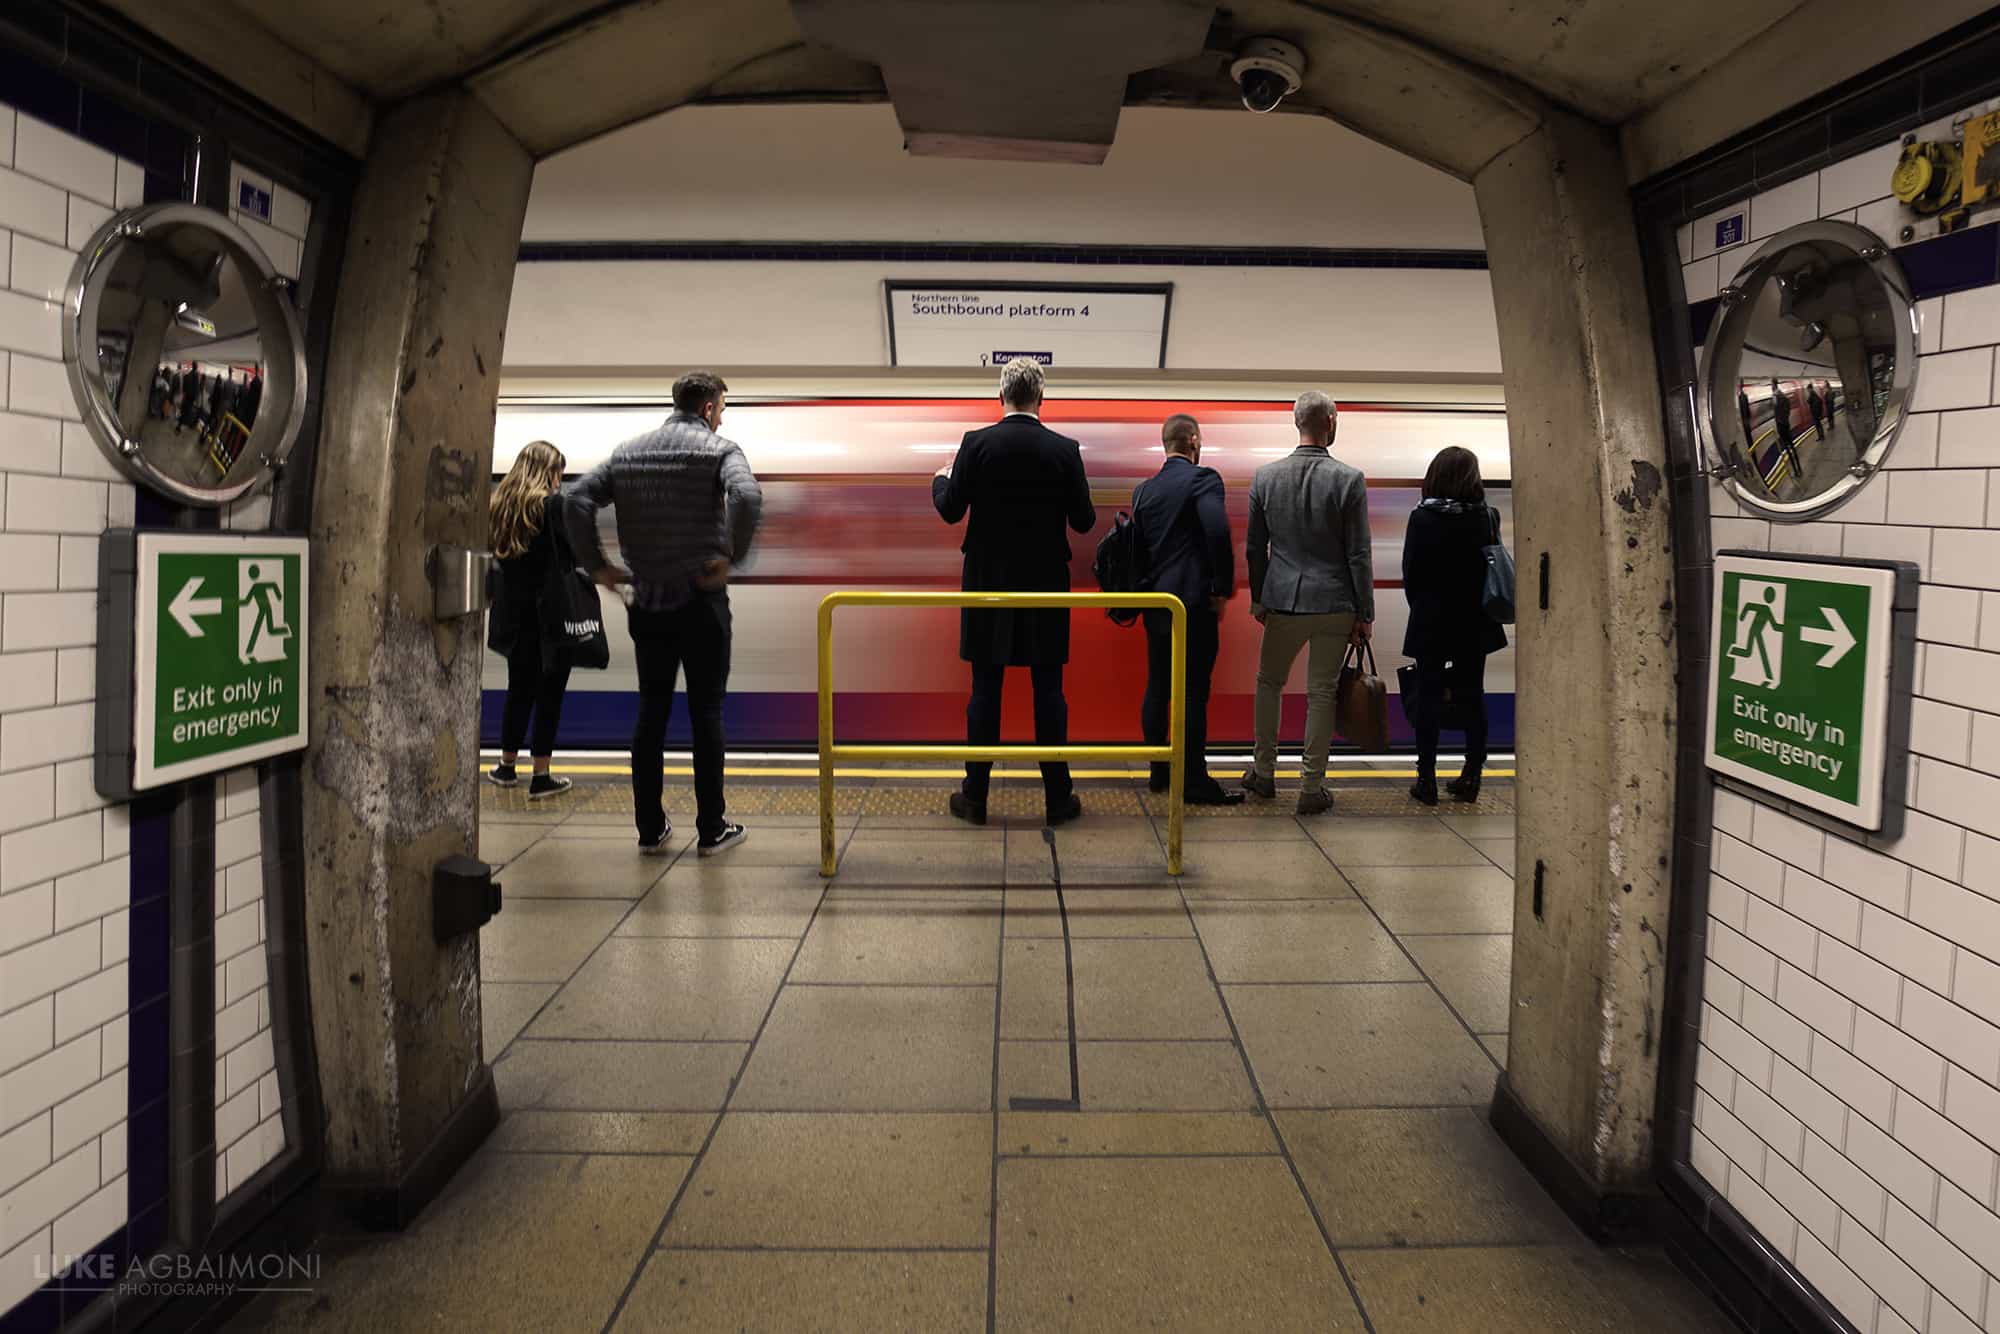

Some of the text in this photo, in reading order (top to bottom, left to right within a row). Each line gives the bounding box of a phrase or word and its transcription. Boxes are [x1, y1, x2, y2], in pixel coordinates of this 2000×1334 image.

[912, 294, 980, 303] Northern line
[912, 303, 1090, 318] Southbound platform 4
[172, 671, 283, 713] Exit only in
[172, 704, 281, 744] emergency
[1733, 695, 1845, 747] Exit only in
[1733, 728, 1843, 781] emergency
